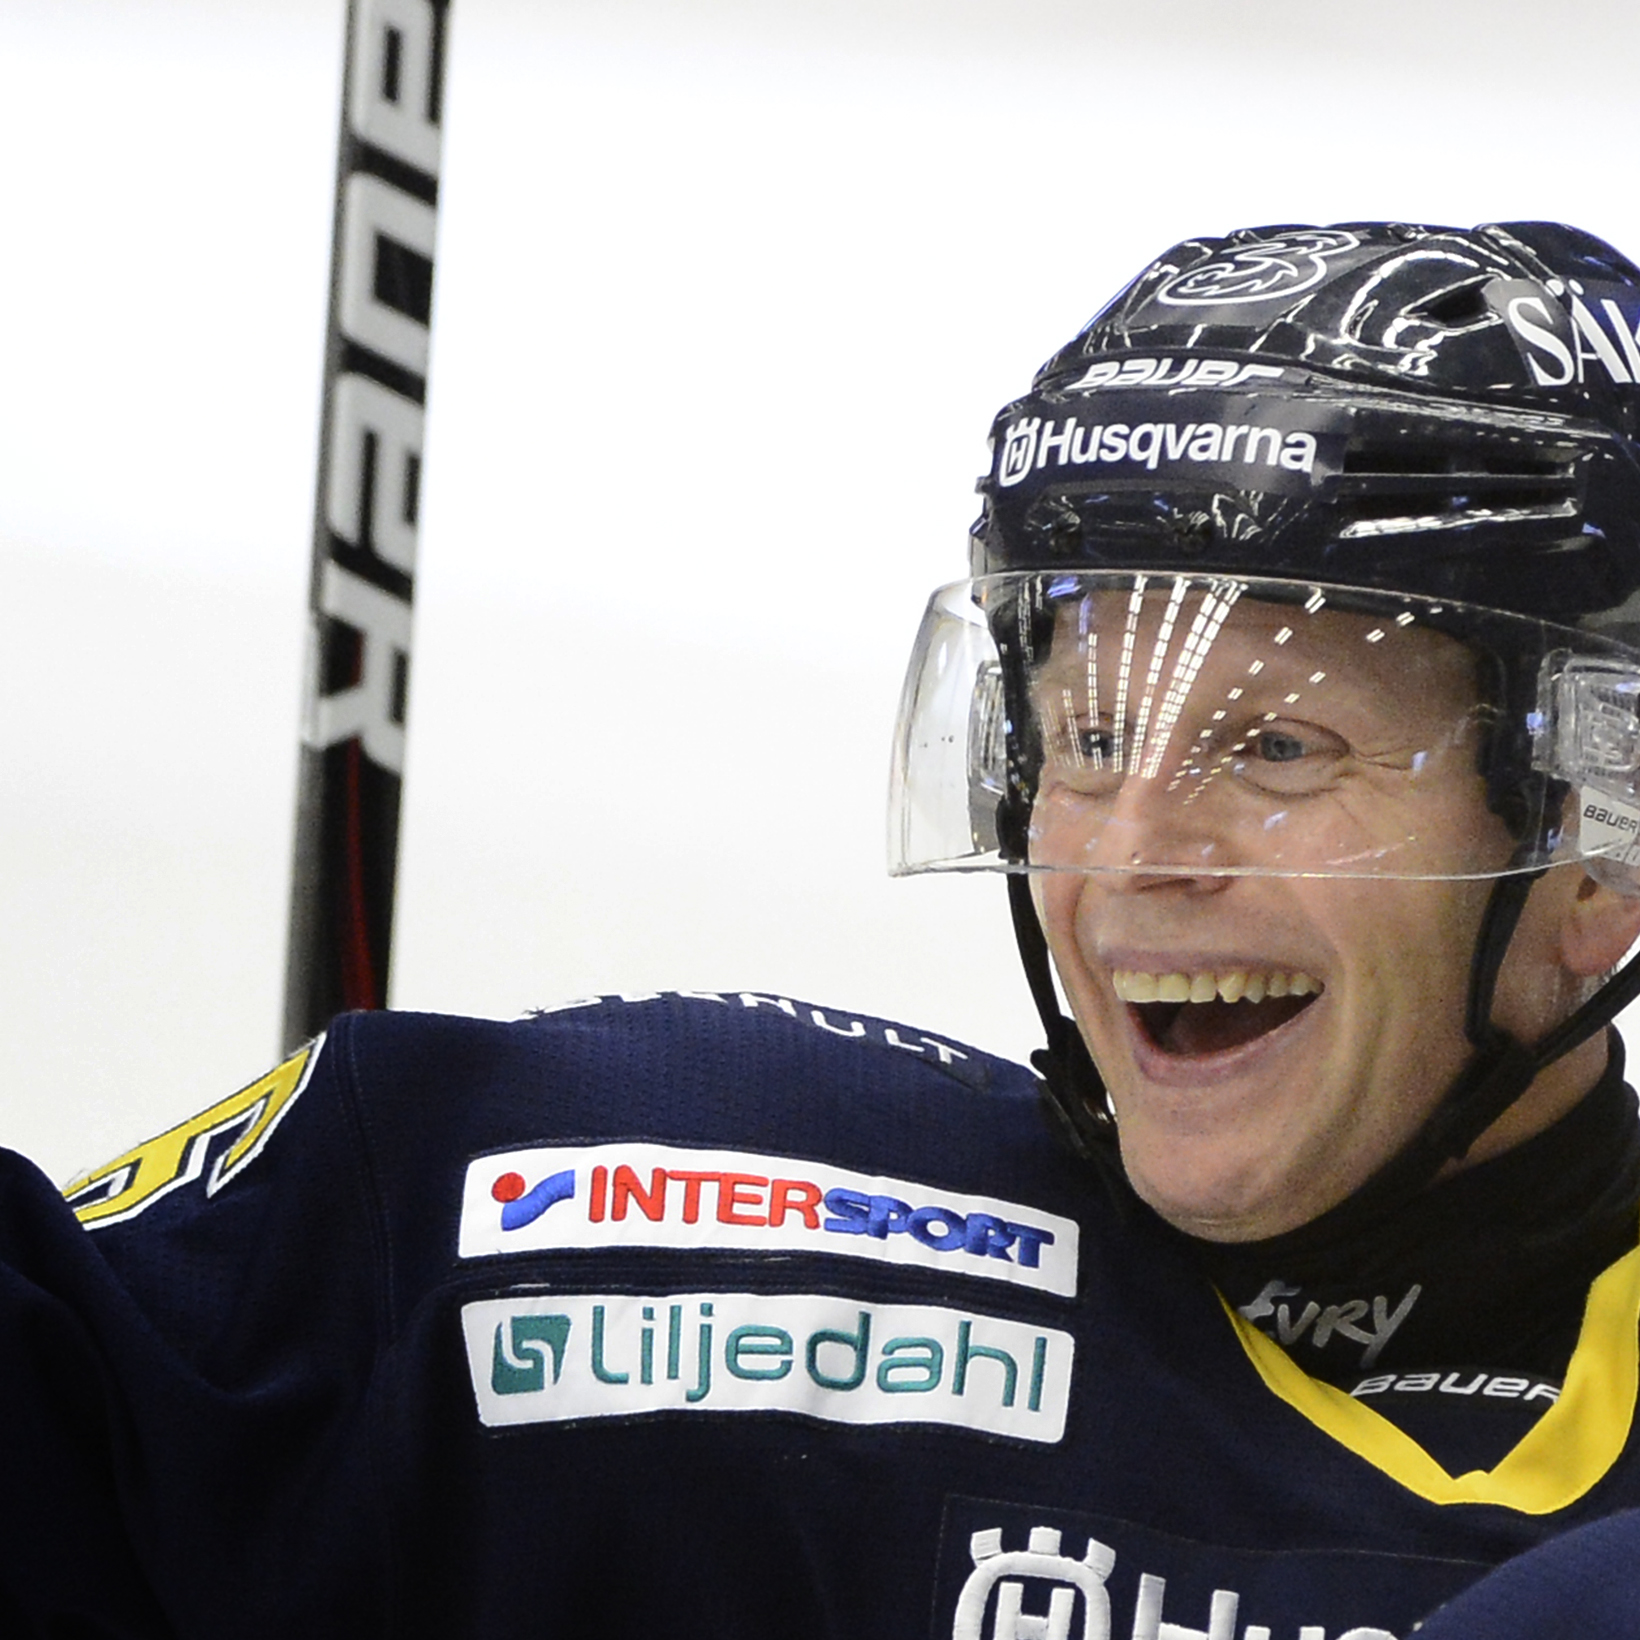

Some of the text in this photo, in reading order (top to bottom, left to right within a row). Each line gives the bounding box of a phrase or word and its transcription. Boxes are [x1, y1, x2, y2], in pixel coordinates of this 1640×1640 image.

[1036, 416, 1318, 472] Husqvarna
[1583, 804, 1638, 834] BAUER
[589, 1163, 1055, 1268] INTERSPORT
[590, 1301, 1048, 1412] Liljedahl
